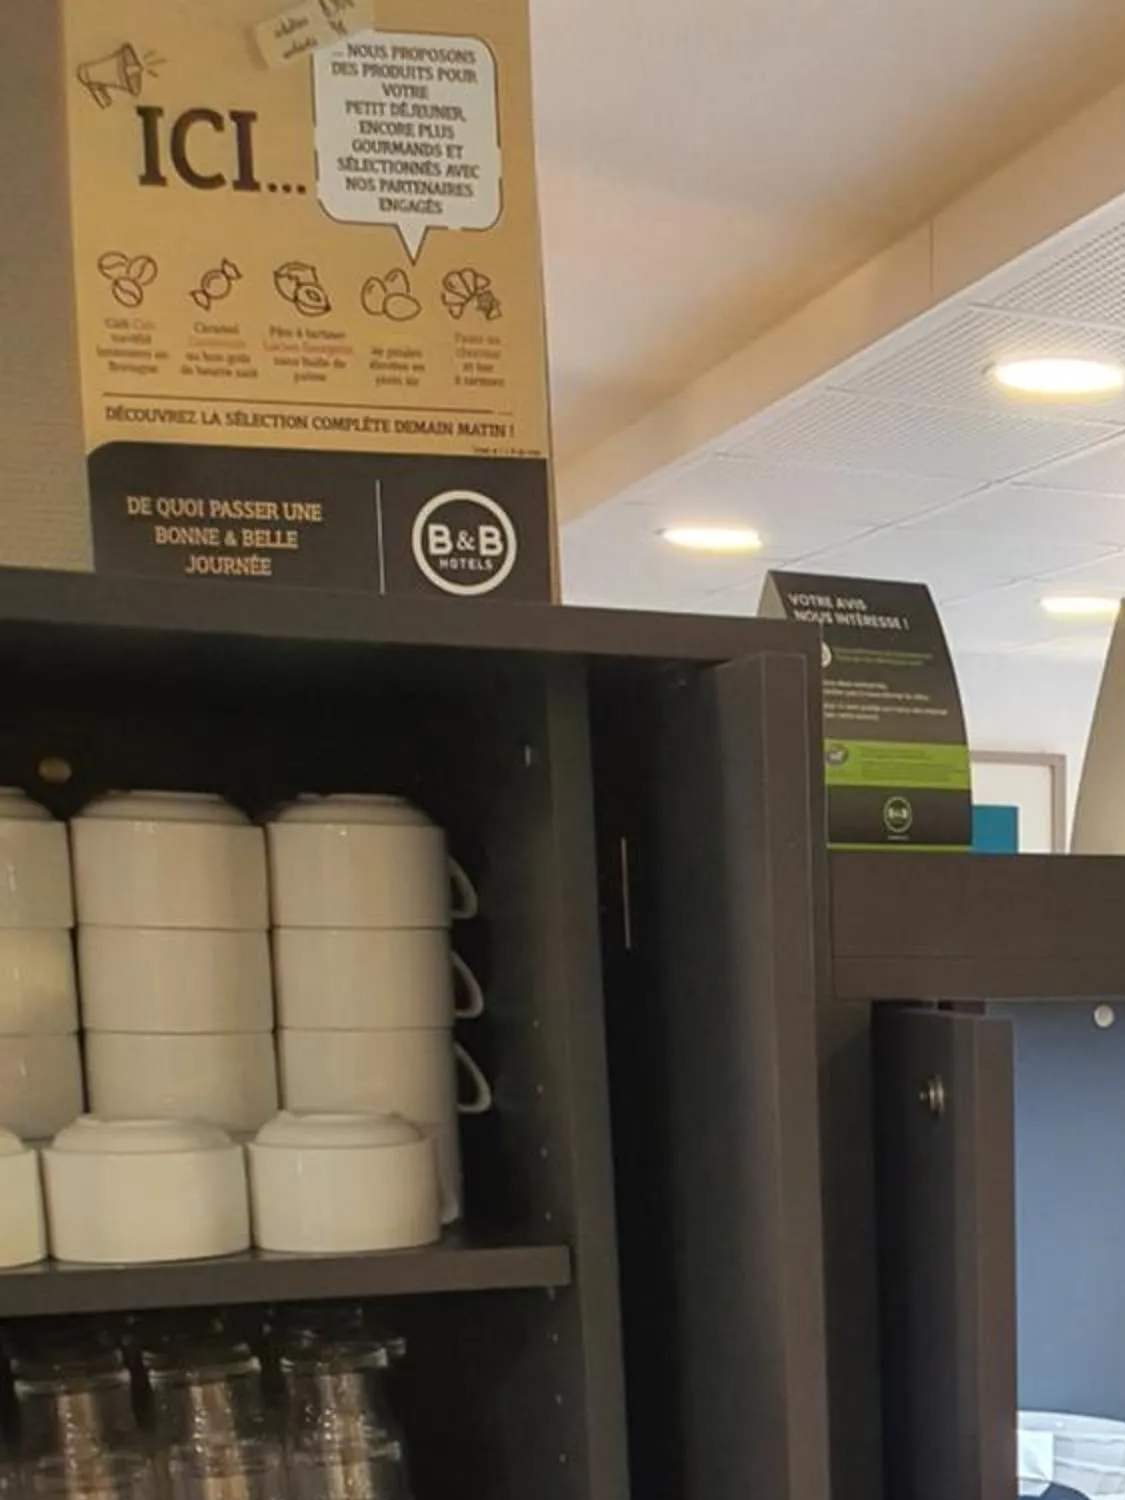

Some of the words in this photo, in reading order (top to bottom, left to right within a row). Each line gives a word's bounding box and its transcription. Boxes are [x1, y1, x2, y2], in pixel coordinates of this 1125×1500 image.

[347, 43, 387, 59] NOUS
[391, 46, 476, 63] PROPOSONS
[330, 61, 358, 77] DES
[362, 63, 434, 80] PRODUITS
[437, 67, 477, 83] POUR
[381, 82, 429, 99] VOTRE
[345, 100, 387, 116] PETIT
[358, 120, 415, 137] ENCORE
[418, 123, 455, 139] PLUS
[136, 105, 306, 194] ICI...
[351, 138, 443, 157] GOURMANDS
[445, 144, 464, 160] ET
[337, 156, 442, 177] SÉLECTIONNÉS
[445, 164, 480, 179] AVEC
[345, 176, 376, 191] NOS
[379, 178, 474, 197] PARTENAIRES
[106, 404, 198, 425] DÉCOUVREZ
[201, 410, 221, 425] LA
[225, 409, 309, 430] SÉLECTION
[394, 419, 454, 437] DEMAIN
[457, 422, 504, 438] MATIN
[126, 495, 153, 516] DE
[156, 497, 205, 519] QUOI
[208, 499, 279, 520] PASSER
[283, 502, 323, 523] UNE
[154, 525, 220, 547] BONNE
[224, 531, 239, 547] &
[242, 529, 300, 549] BELLE
[185, 554, 273, 577] JOURNÉE
[439, 557, 494, 571] HOTELS
[788, 593, 833, 609] VOTRE
[836, 596, 867, 611] AVIS
[793, 608, 833, 624] NOUS
